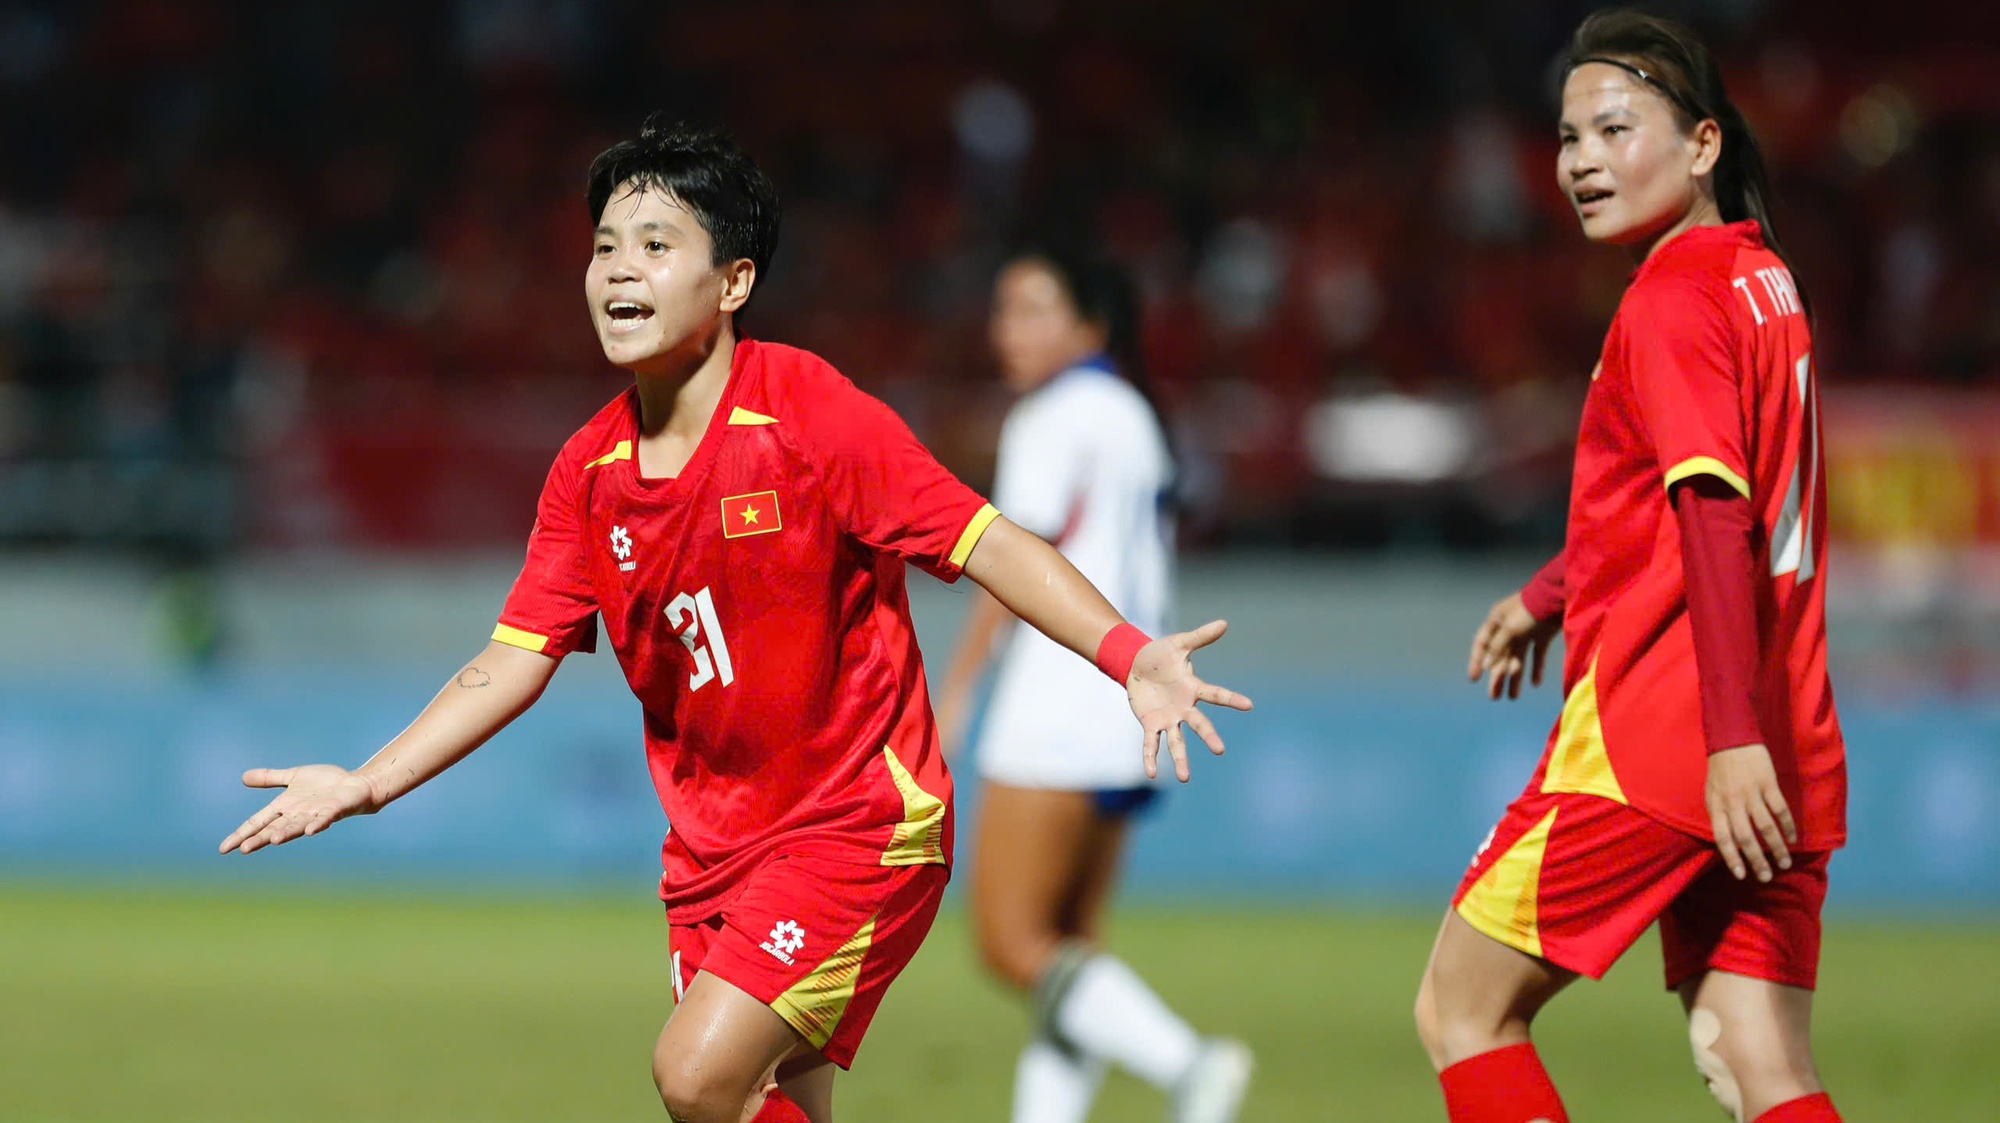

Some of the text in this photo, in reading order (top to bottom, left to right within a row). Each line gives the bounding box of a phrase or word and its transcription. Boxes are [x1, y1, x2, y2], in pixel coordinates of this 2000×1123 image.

[1733, 276, 1768, 326] T.
[663, 585, 734, 692] 21
[759, 941, 796, 966] JOGARBOLA
